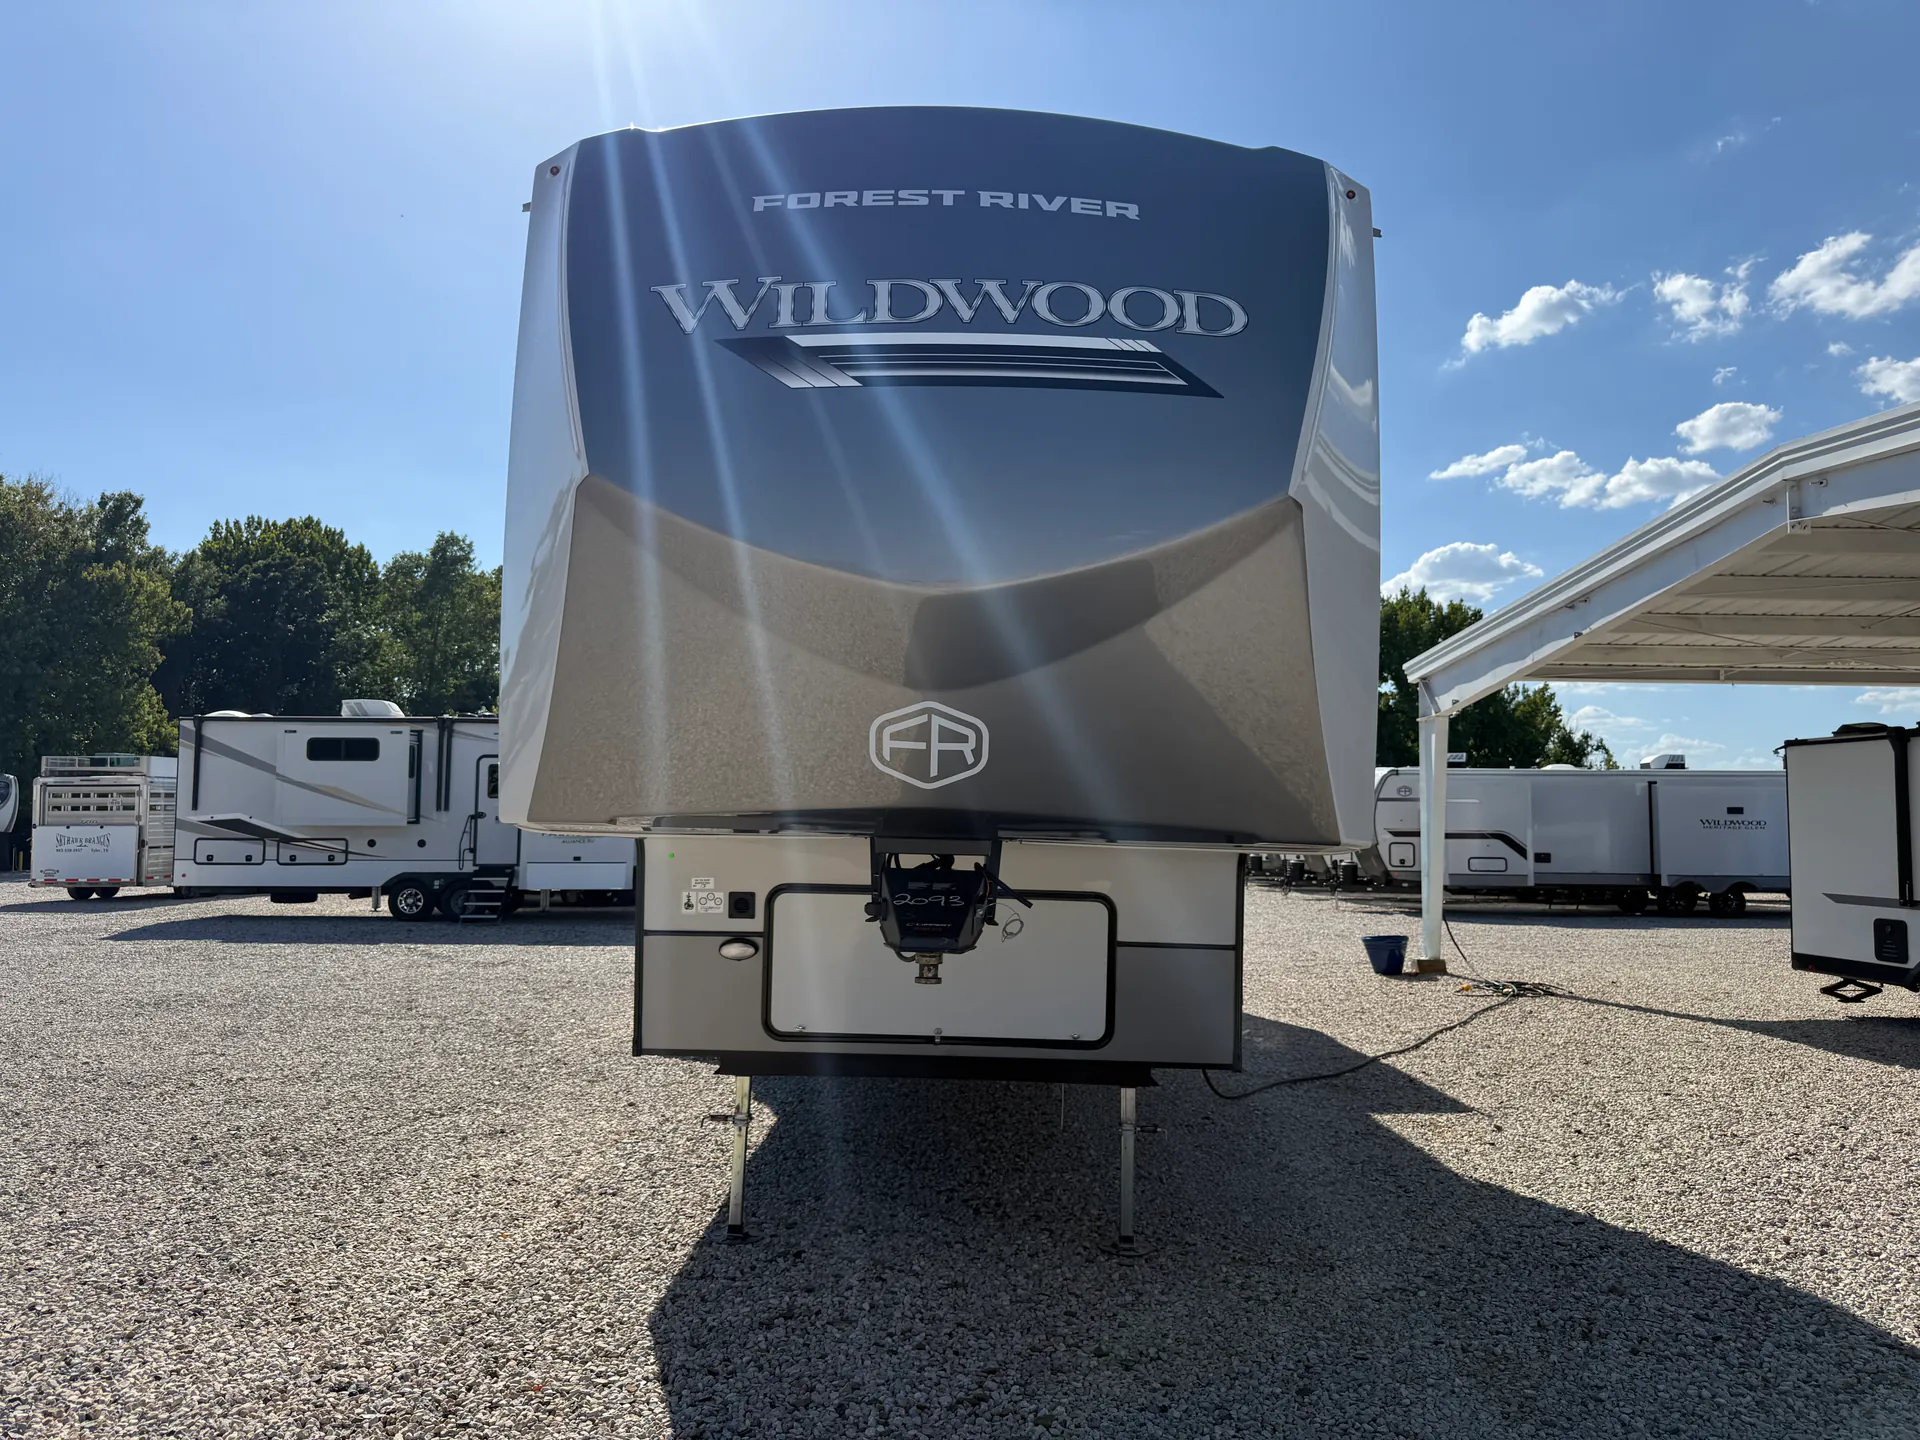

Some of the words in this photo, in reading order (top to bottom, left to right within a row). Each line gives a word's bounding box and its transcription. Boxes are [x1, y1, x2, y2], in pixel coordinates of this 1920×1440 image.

[752, 189, 966, 212] FOREST
[976, 190, 1141, 220] RIVER
[650, 276, 1249, 337] WILDWOOD
[1699, 819, 1767, 827] WILDWOOD
[893, 893, 965, 907] 2093
